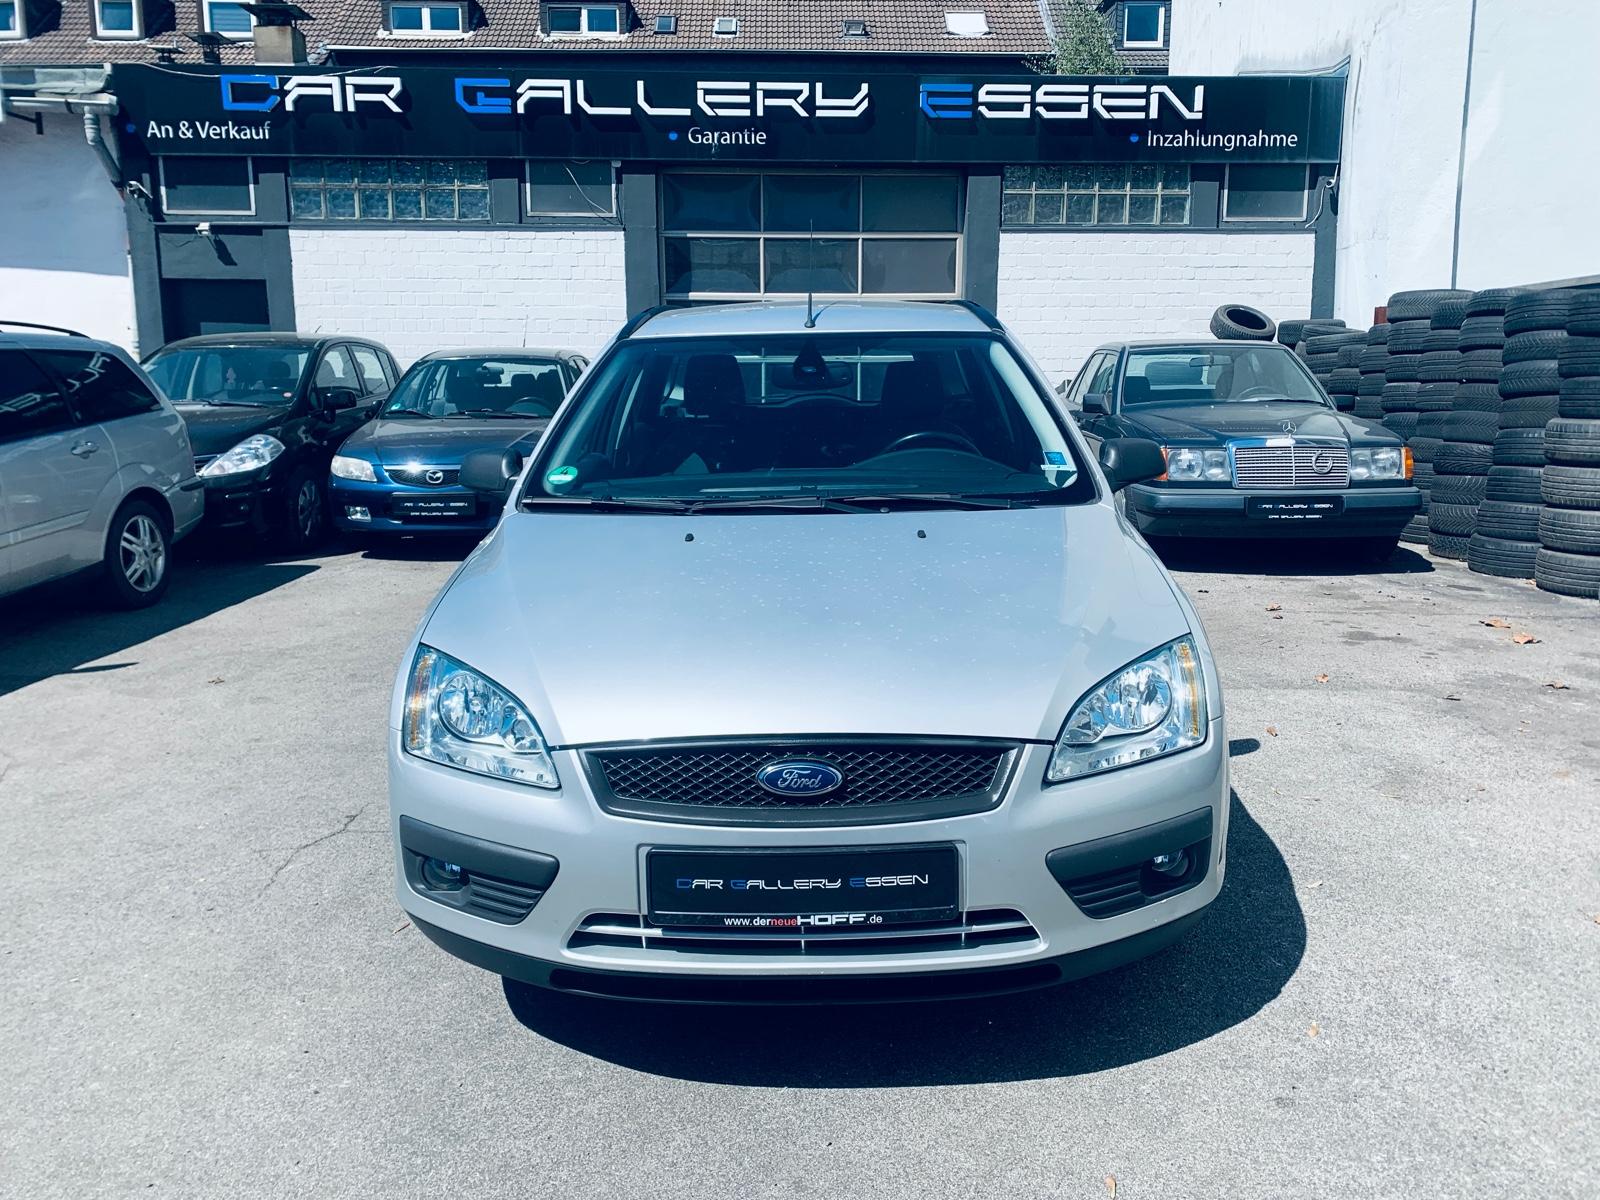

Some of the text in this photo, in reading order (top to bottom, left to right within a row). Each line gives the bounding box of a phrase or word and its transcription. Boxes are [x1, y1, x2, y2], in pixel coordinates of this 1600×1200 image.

[220, 74, 1205, 120] CAR GALLERY ESSEN
[147, 120, 271, 140] An & Verkauf
[687, 126, 767, 145] Garantie
[1147, 128, 1298, 152] Inzahlungnahme
[777, 768, 823, 788] Ford
[676, 874, 929, 890] CAR GALLERY ESSEN
